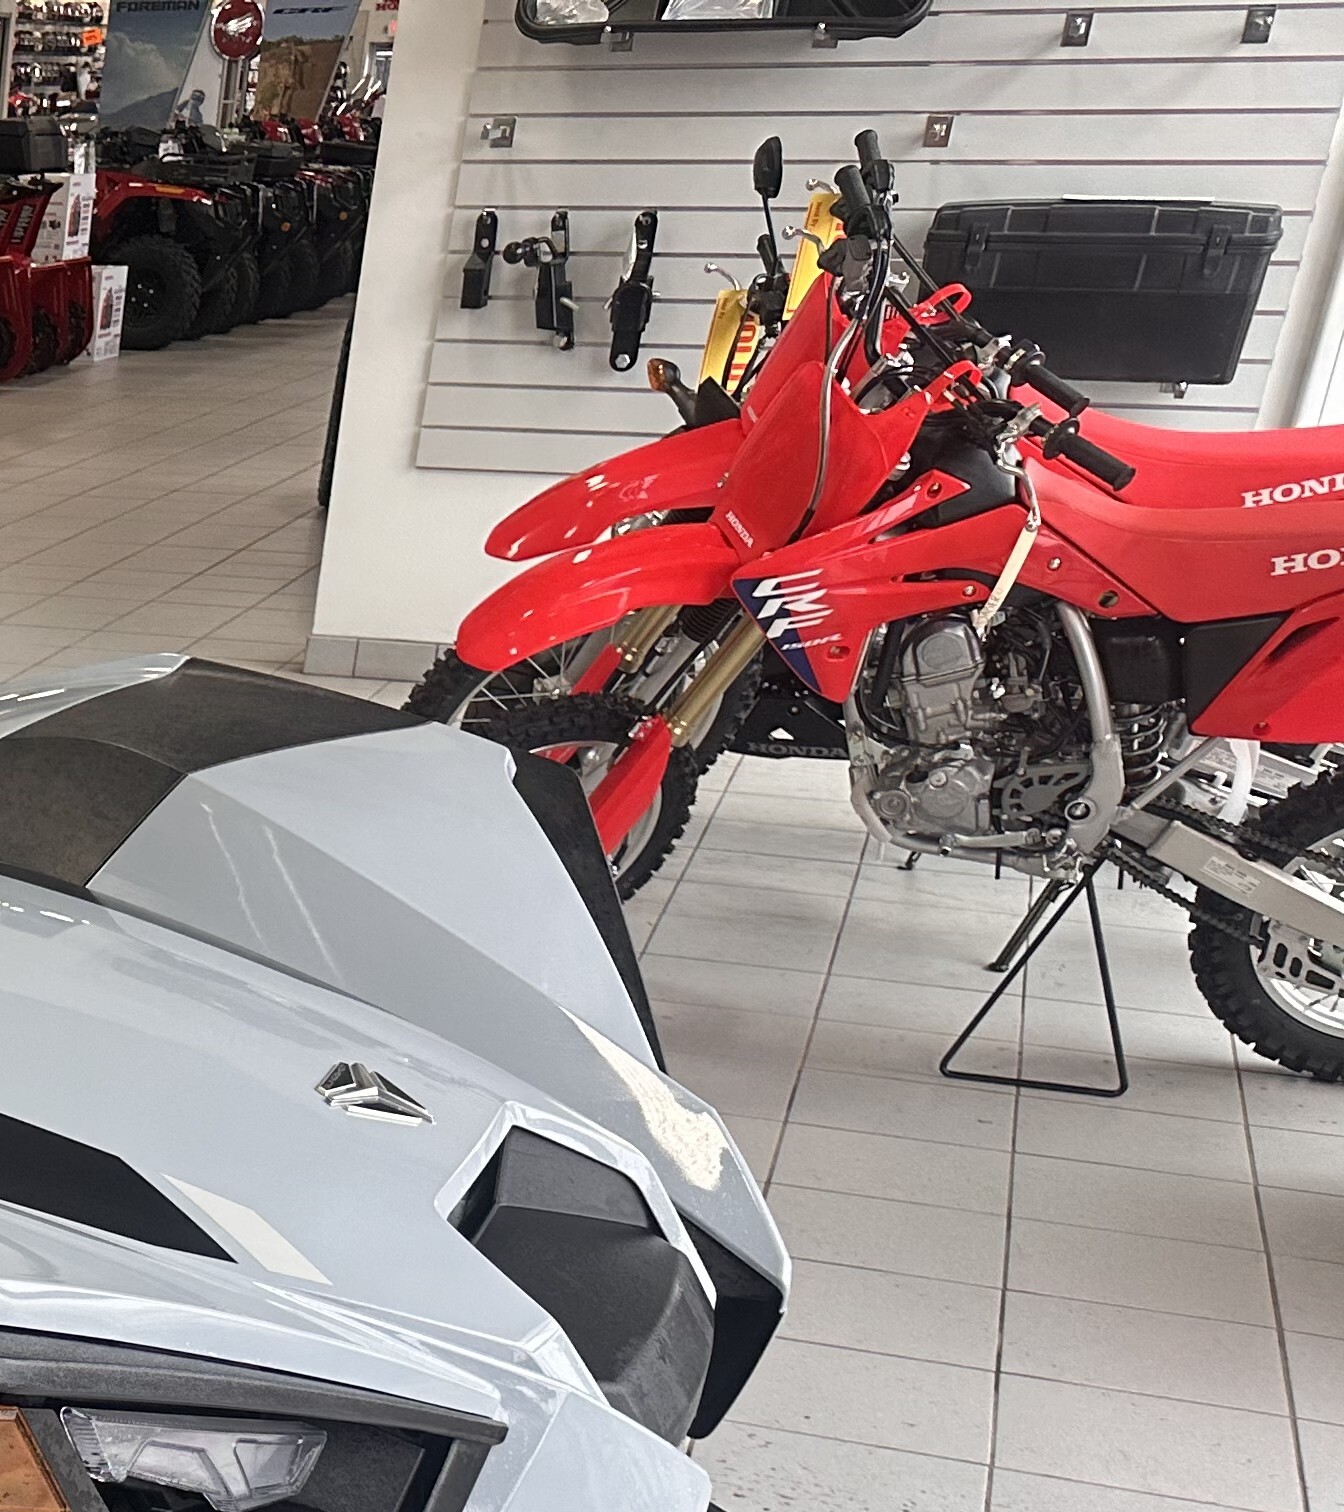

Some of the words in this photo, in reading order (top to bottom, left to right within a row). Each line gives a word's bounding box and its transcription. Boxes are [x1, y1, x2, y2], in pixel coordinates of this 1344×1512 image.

[116, 0, 199, 12] FOREMAN
[725, 510, 755, 549] HONDA
[1270, 548, 1344, 576] HO
